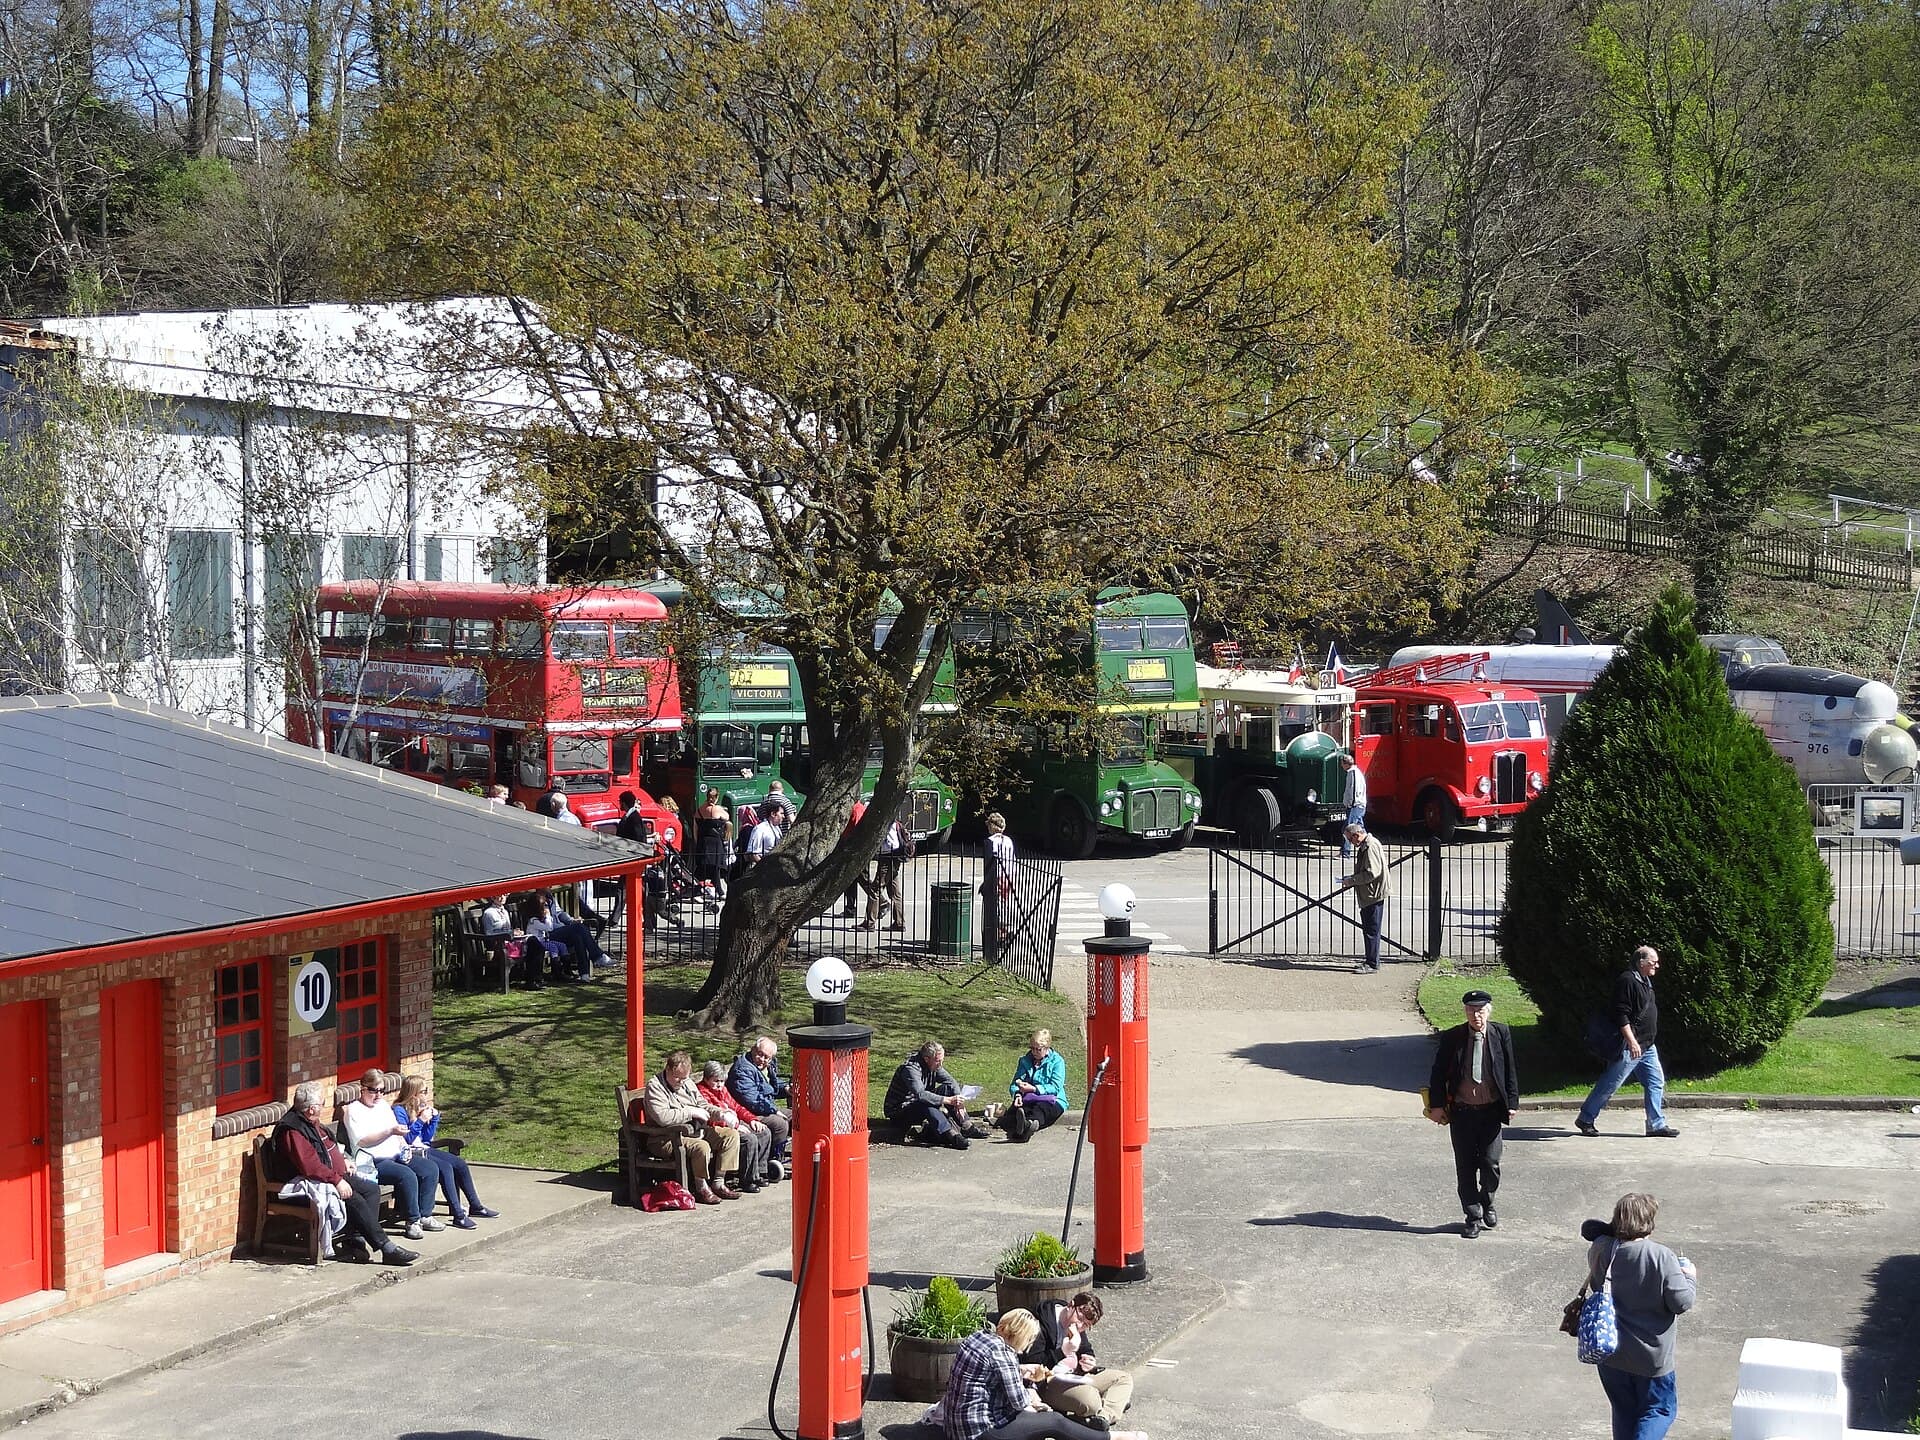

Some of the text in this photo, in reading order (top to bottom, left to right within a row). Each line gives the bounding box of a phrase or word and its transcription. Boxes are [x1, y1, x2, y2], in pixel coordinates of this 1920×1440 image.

[582, 673, 600, 689] 36
[736, 689, 783, 698] VICTORIA
[583, 695, 645, 706] PRIVATE PARTY
[1807, 743, 1829, 754] 976
[300, 972, 325, 1012] 10
[821, 978, 853, 994] SHE
